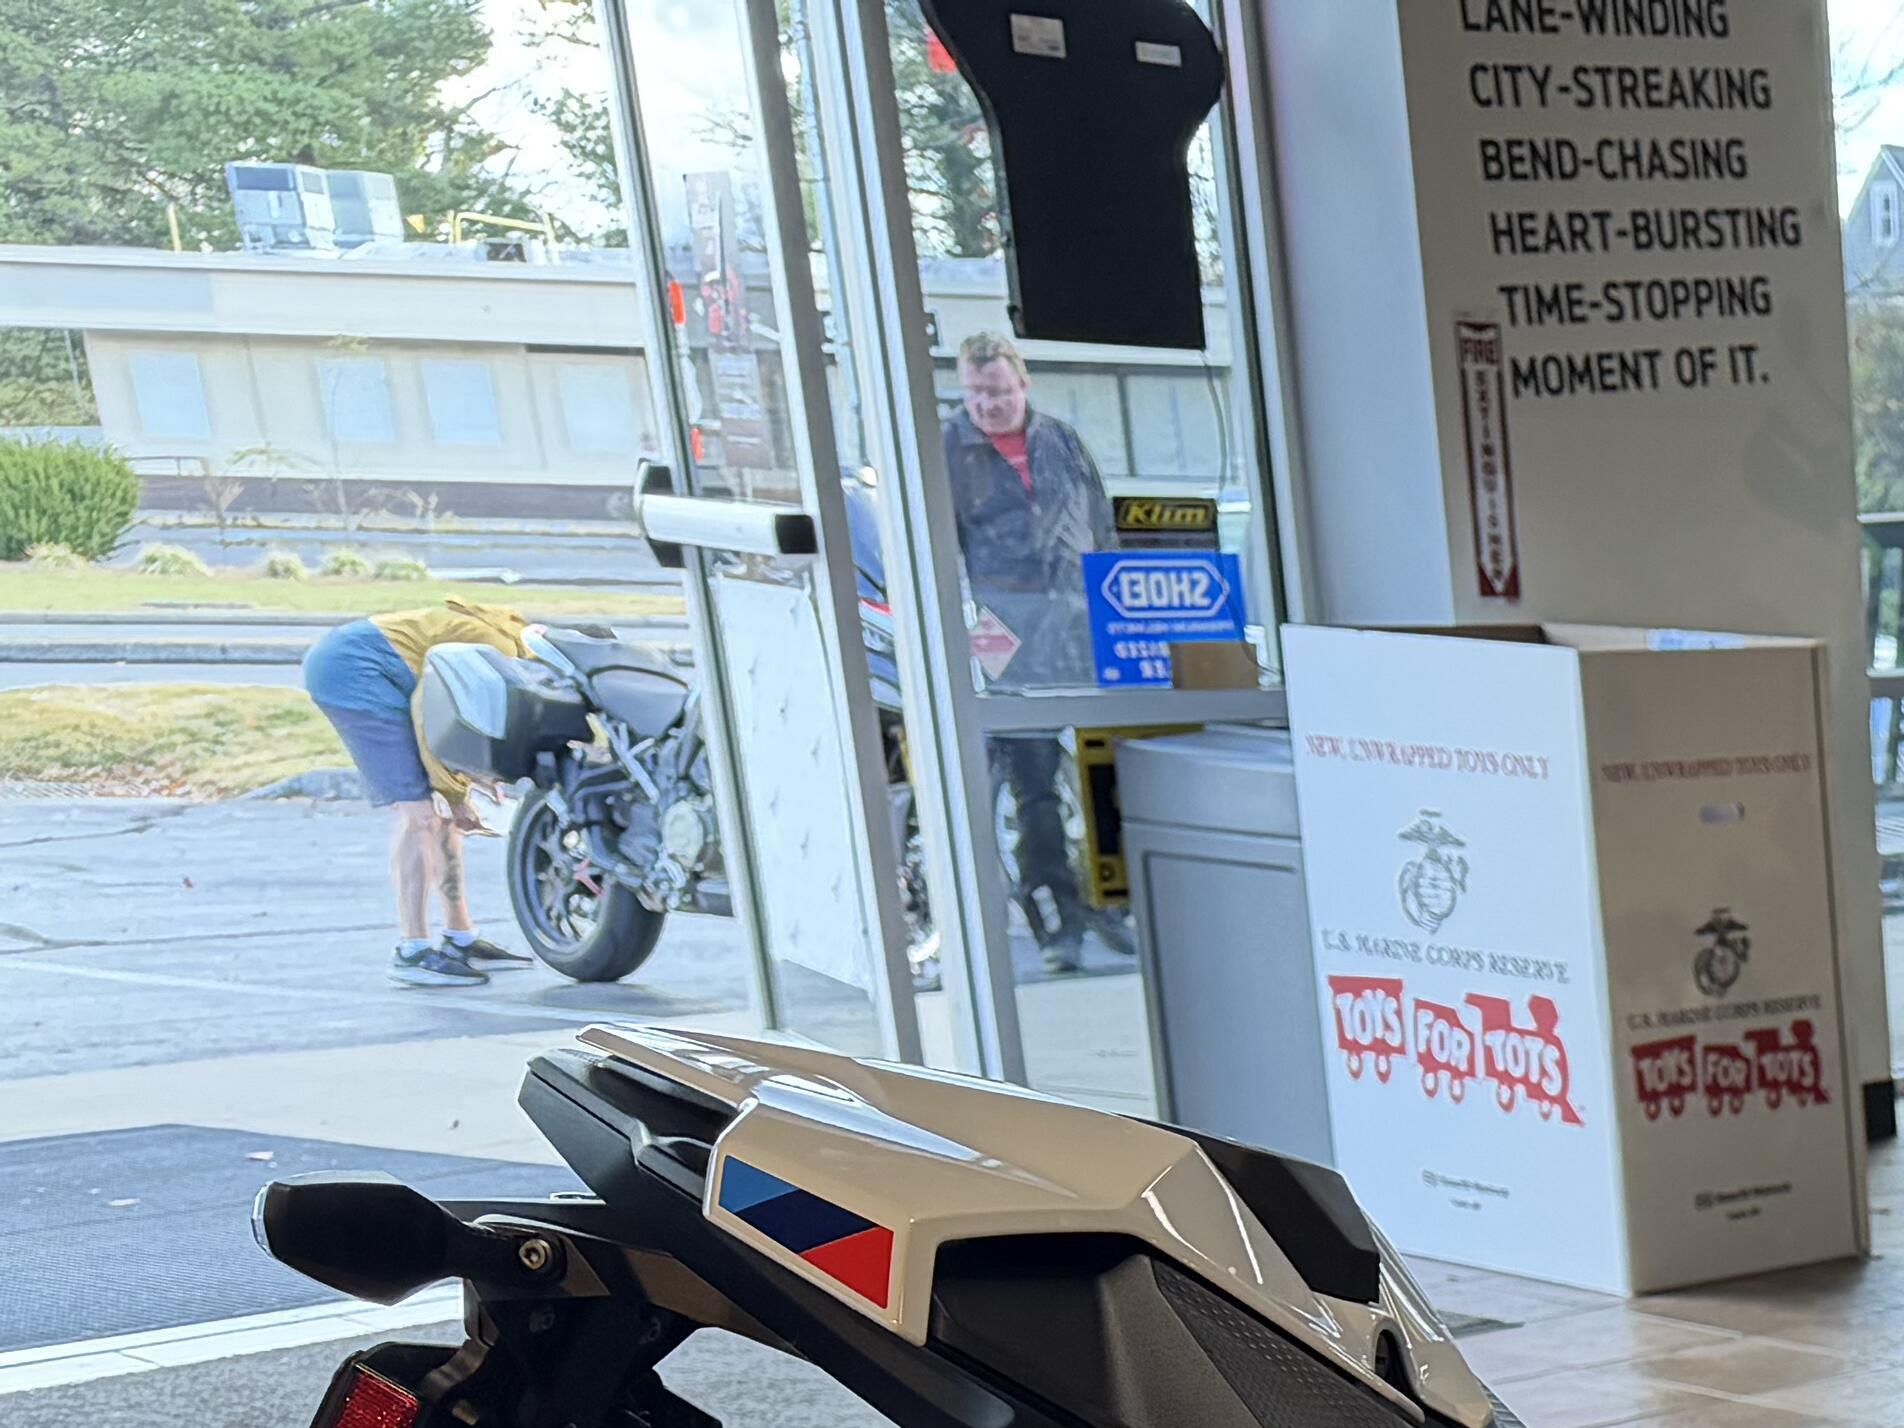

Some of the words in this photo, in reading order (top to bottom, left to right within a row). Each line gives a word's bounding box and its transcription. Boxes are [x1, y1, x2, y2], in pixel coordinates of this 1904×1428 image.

[1461, 0, 1730, 38] LANE-WINDING
[1469, 63, 1772, 110] CITY-STREAKING
[1479, 138, 1748, 182] BEND-CHASING
[1489, 207, 1802, 255] HEART-BURSTING
[1498, 276, 1772, 328] TIME-STOPPING
[1510, 348, 1661, 398] MOMENT
[1675, 348, 1717, 388] OF
[1729, 345, 1769, 384] IT.
[1335, 988, 1403, 1049] TOYS
[1417, 1009, 1469, 1073] FOR
[1484, 1029, 1563, 1097] TOTS
[1636, 1046, 1695, 1094] TOYS
[1703, 1050, 1750, 1092] FOR
[1762, 1049, 1815, 1089] TOTS
